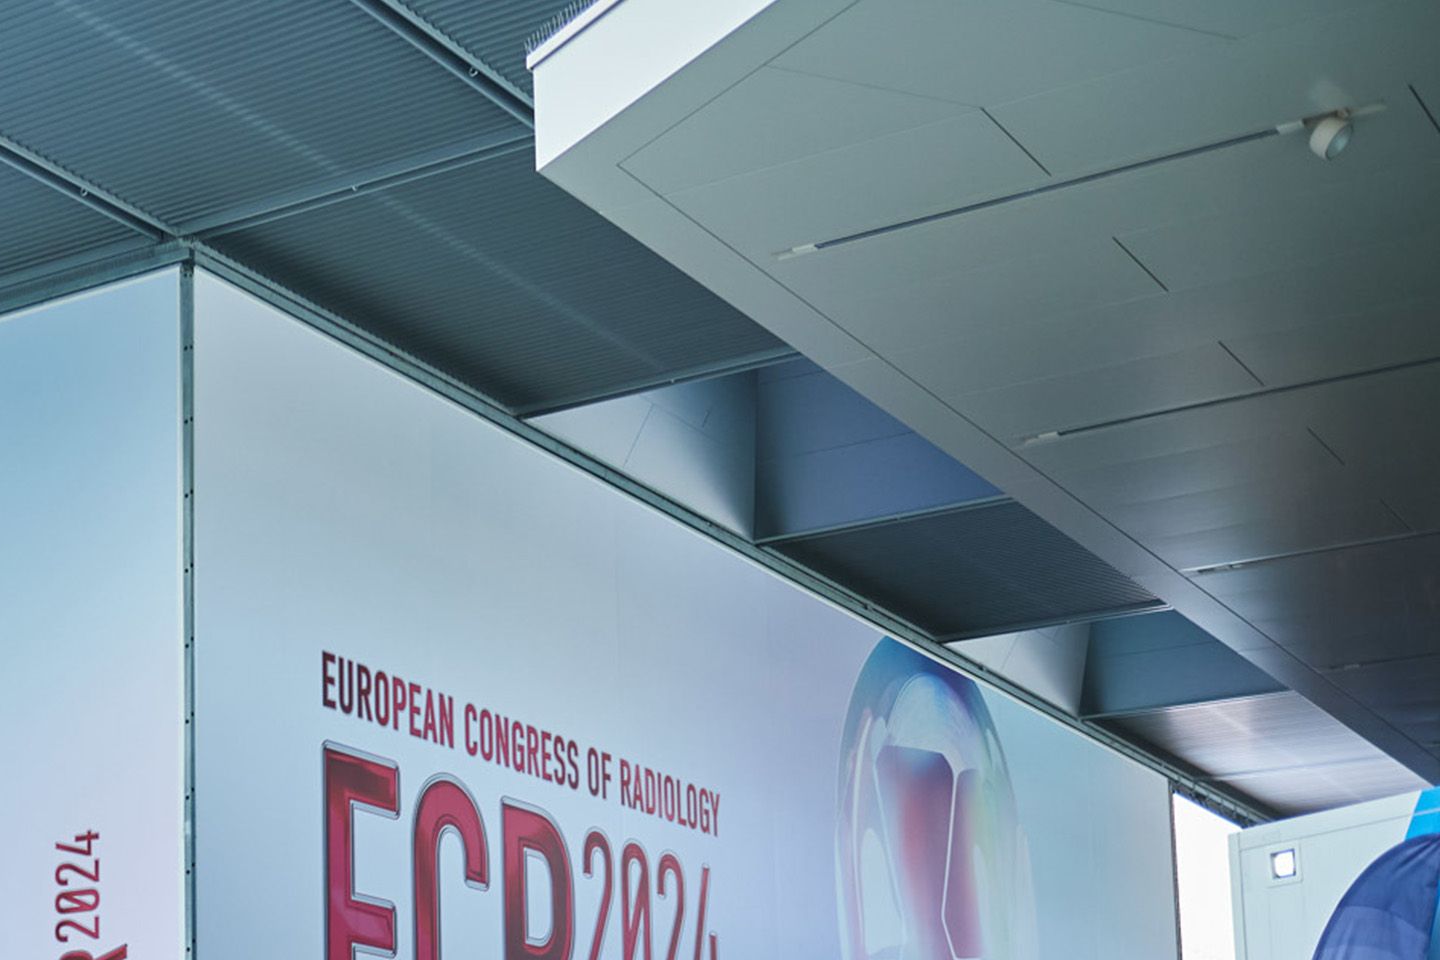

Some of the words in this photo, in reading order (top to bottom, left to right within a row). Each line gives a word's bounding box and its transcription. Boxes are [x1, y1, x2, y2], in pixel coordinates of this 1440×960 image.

[322, 650, 455, 749] EUROPEAN
[464, 703, 579, 790] CONGRESS
[587, 747, 612, 799] OF
[620, 758, 720, 838] RADIOLOGY
